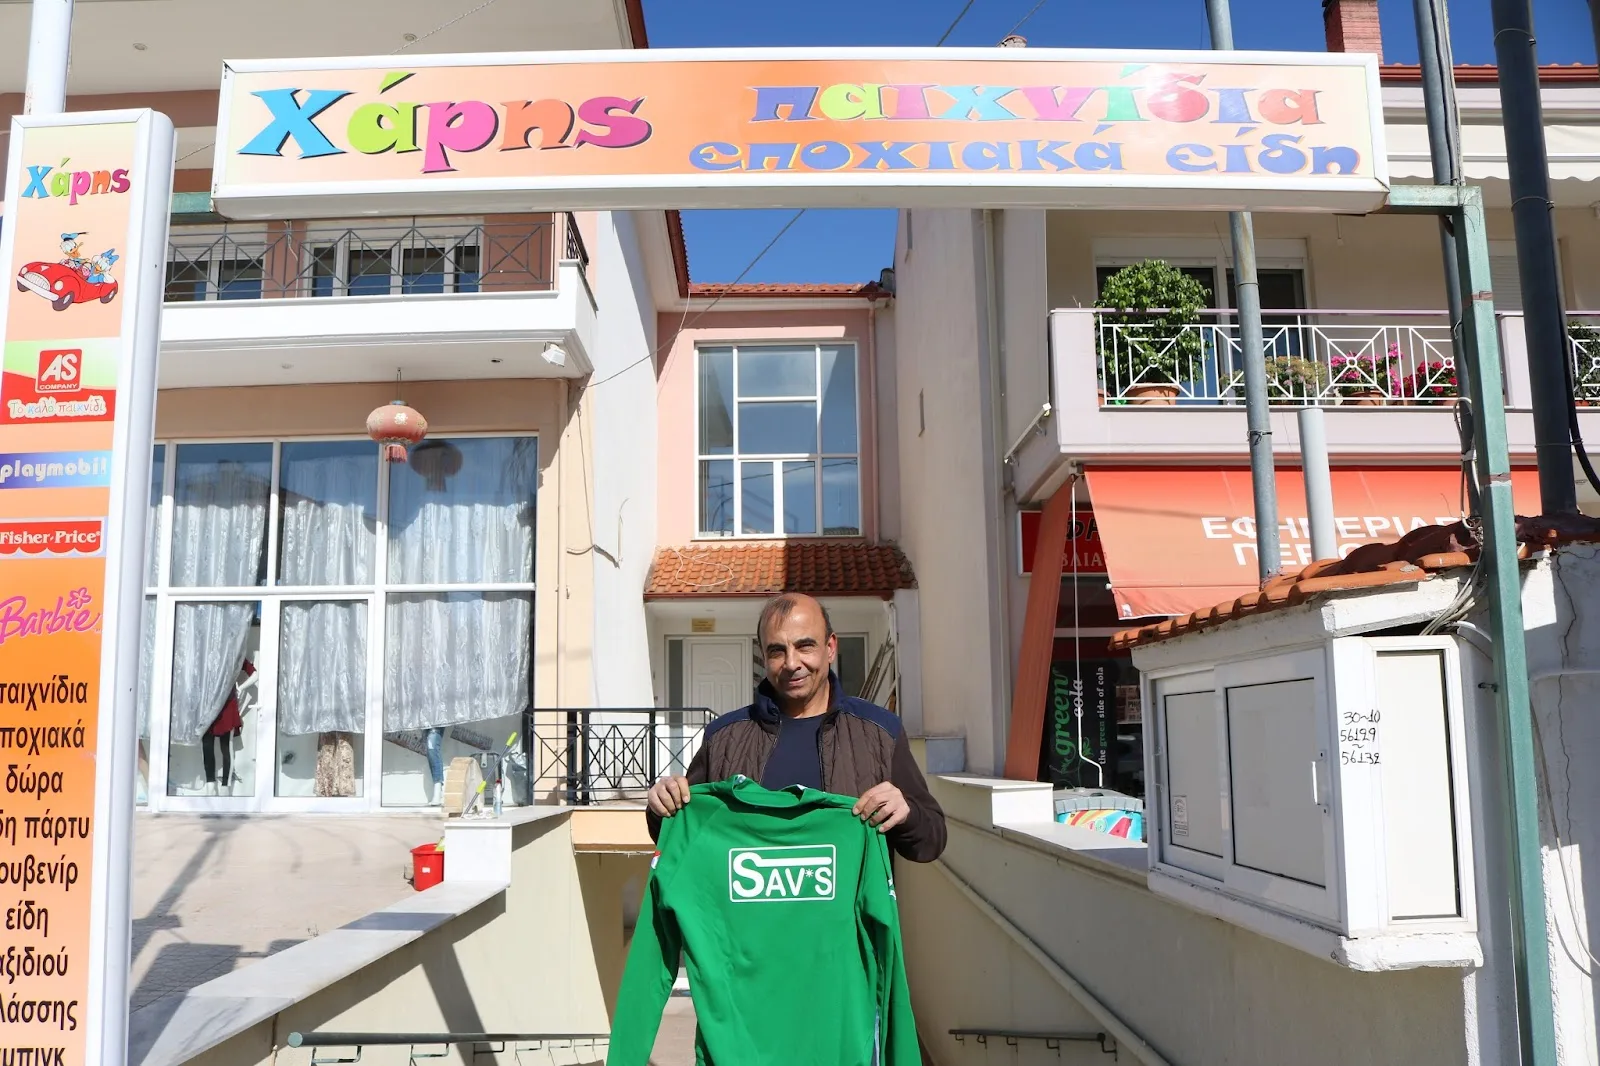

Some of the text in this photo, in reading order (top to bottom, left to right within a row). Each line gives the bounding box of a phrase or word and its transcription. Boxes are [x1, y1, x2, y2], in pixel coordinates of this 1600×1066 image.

[751, 63, 1322, 126] παιχνίδια
[689, 124, 1360, 176] εποχιακά είδη
[41, 353, 78, 381] AS
[0, 457, 107, 483] playmobil
[0, 588, 102, 645] Barbie
[1096, 666, 1104, 685] cola
[1096, 687, 1104, 697] of
[1054, 666, 1076, 756] green
[1097, 699, 1105, 718] side
[1098, 749, 1106, 765] the
[6, 764, 63, 800] δώρα
[24, 809, 90, 846] πάρτυ
[5, 900, 49, 937] είδη
